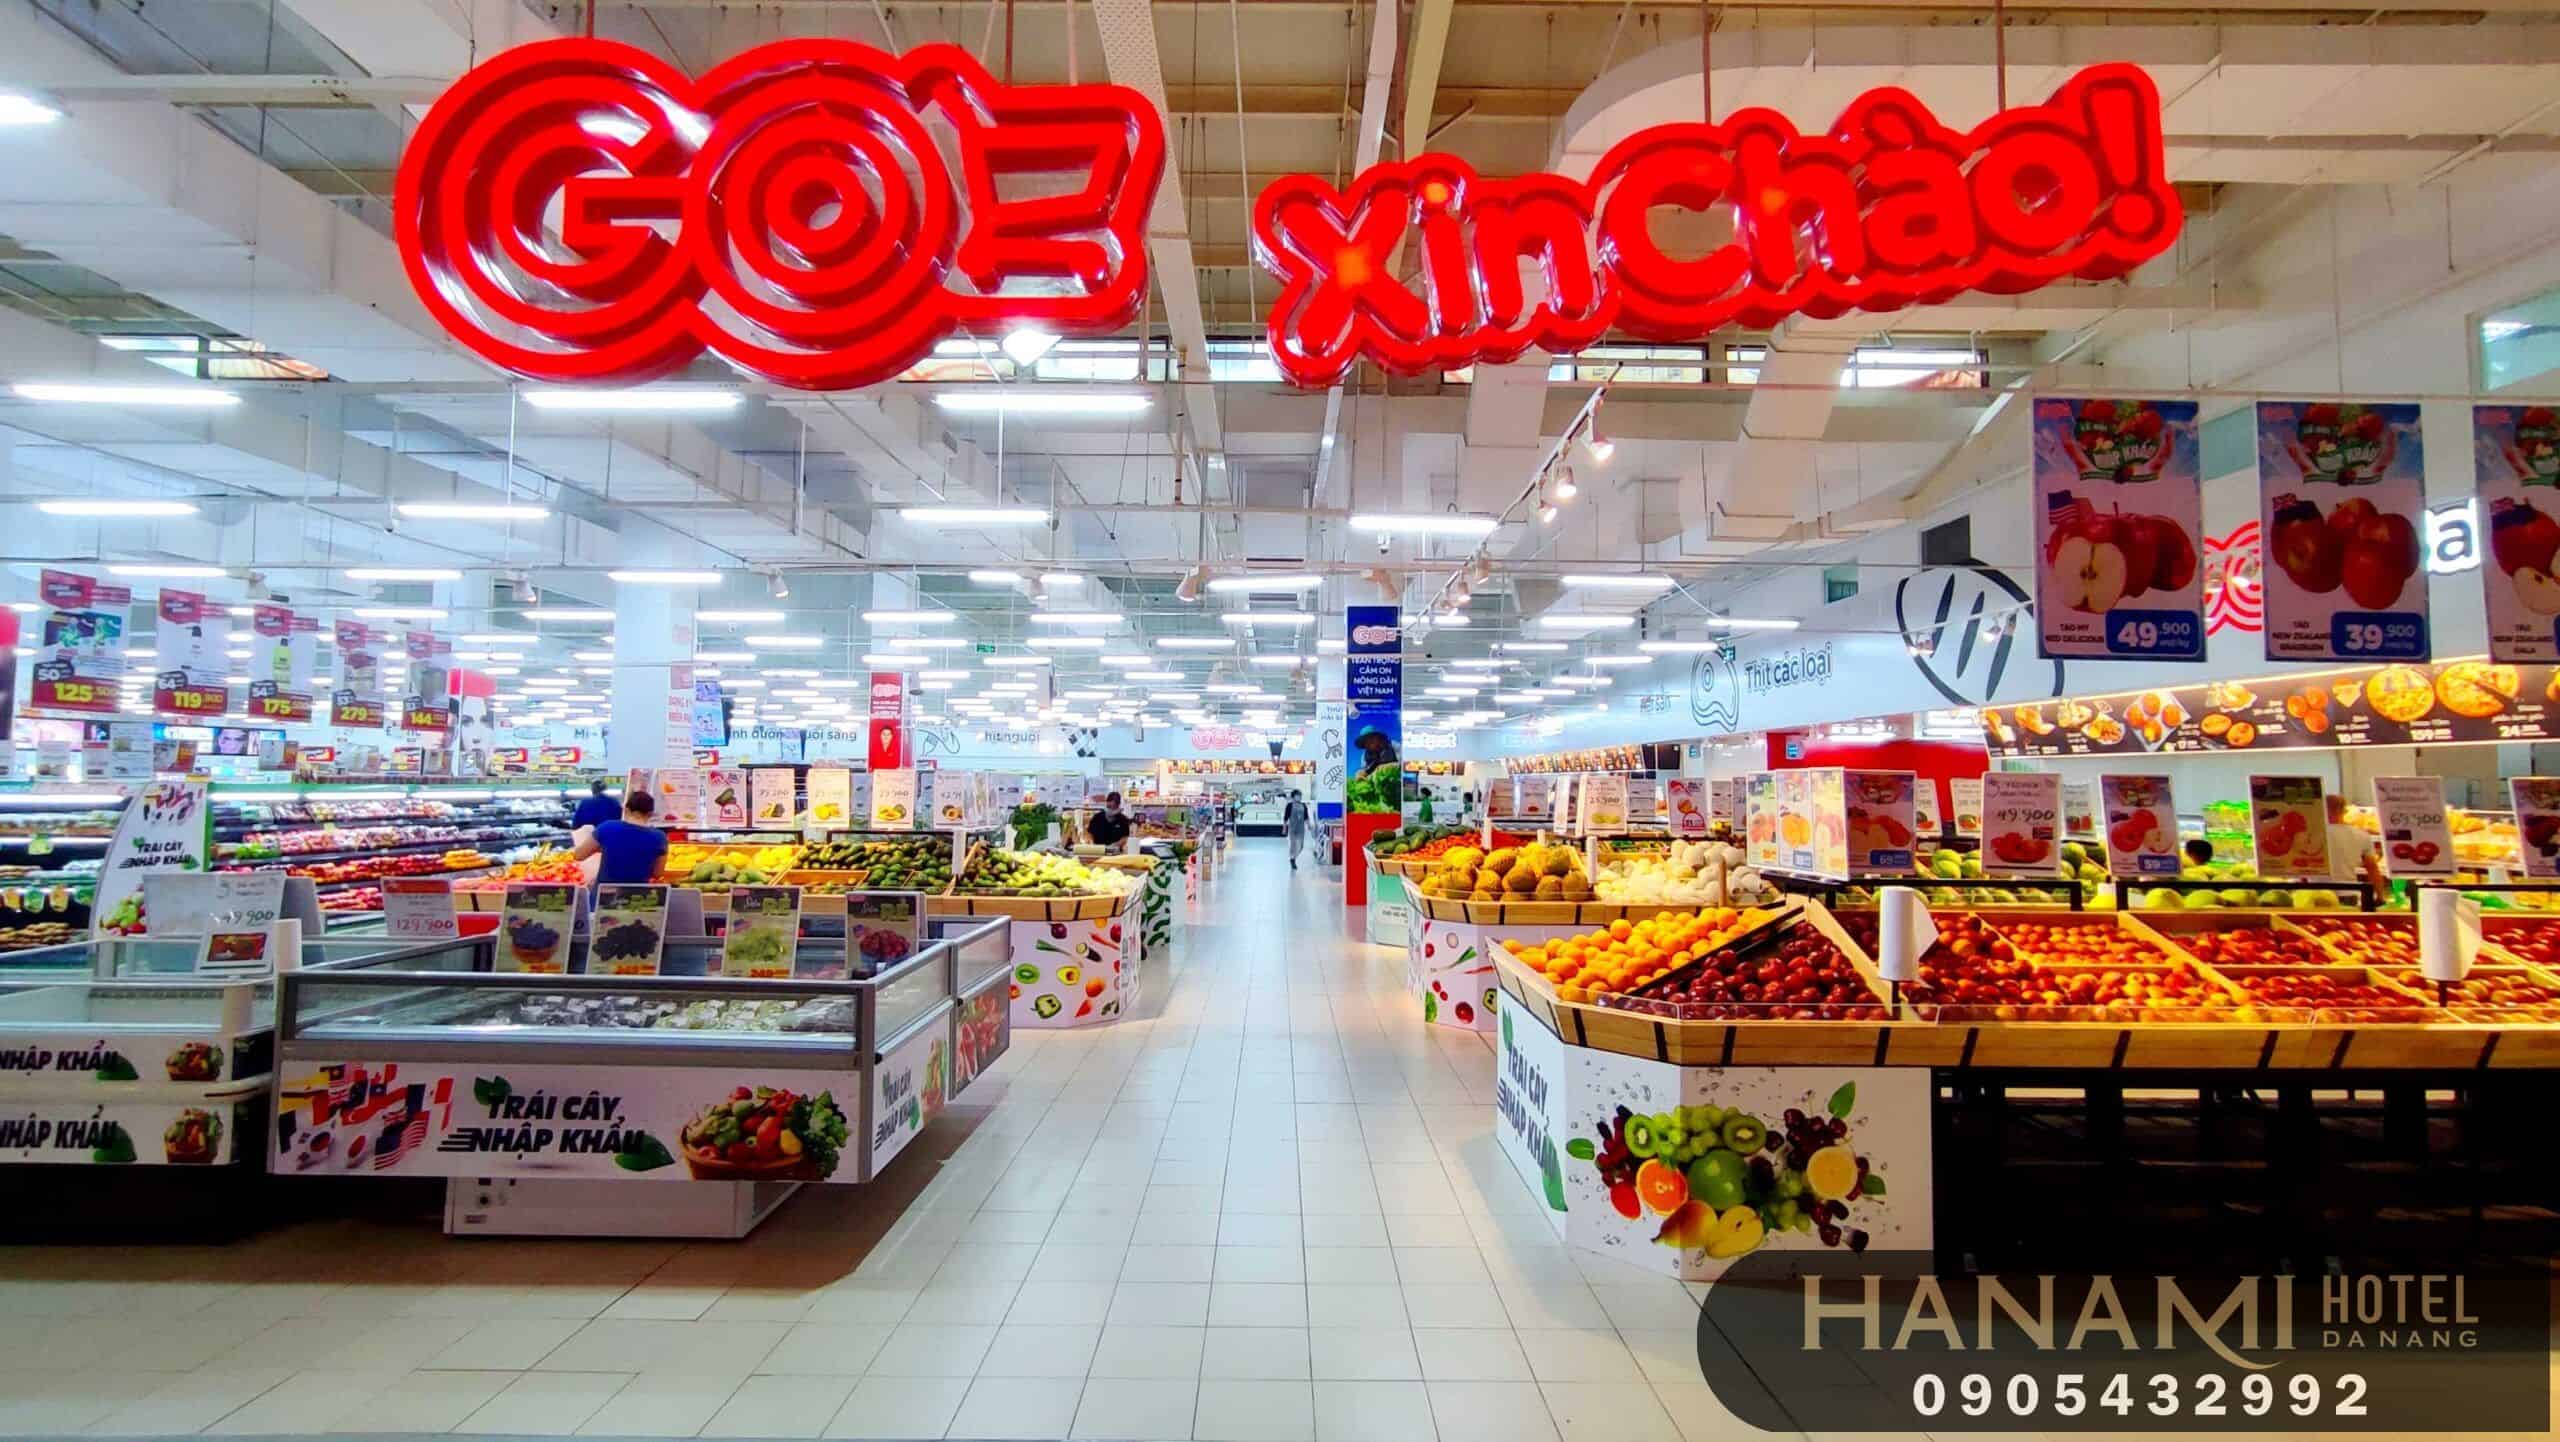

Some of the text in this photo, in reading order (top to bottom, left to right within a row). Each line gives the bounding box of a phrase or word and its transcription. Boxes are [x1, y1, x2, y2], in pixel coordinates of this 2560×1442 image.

[488, 1089, 559, 1120] TRÁI
[469, 1117, 645, 1160] NHẬP KHẨU
